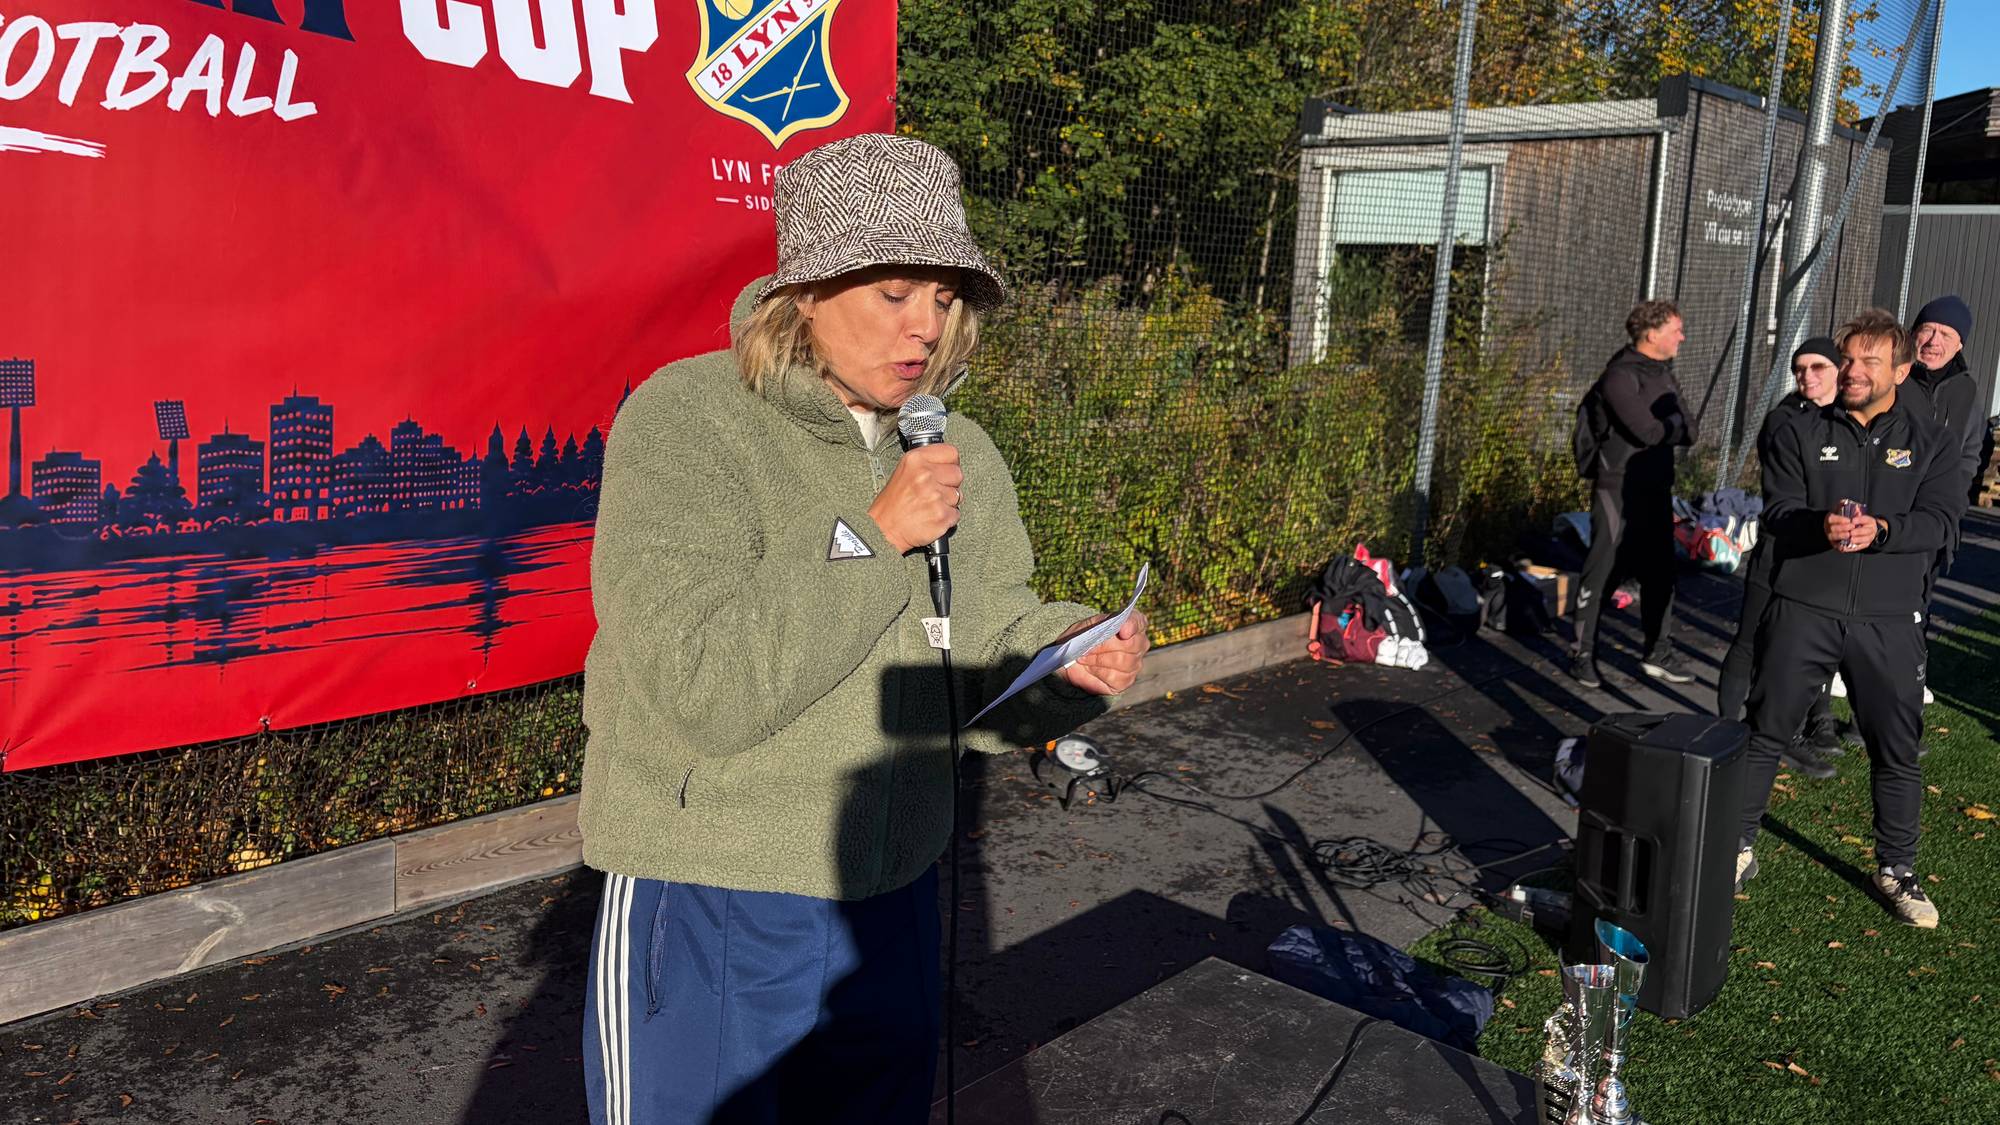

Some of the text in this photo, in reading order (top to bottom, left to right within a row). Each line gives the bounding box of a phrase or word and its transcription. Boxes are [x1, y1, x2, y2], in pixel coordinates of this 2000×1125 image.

[0, 15, 318, 122] OTBALL
[711, 0, 800, 88] 18 LYN
[711, 157, 752, 184] LYN
[744, 194, 775, 212] SID
